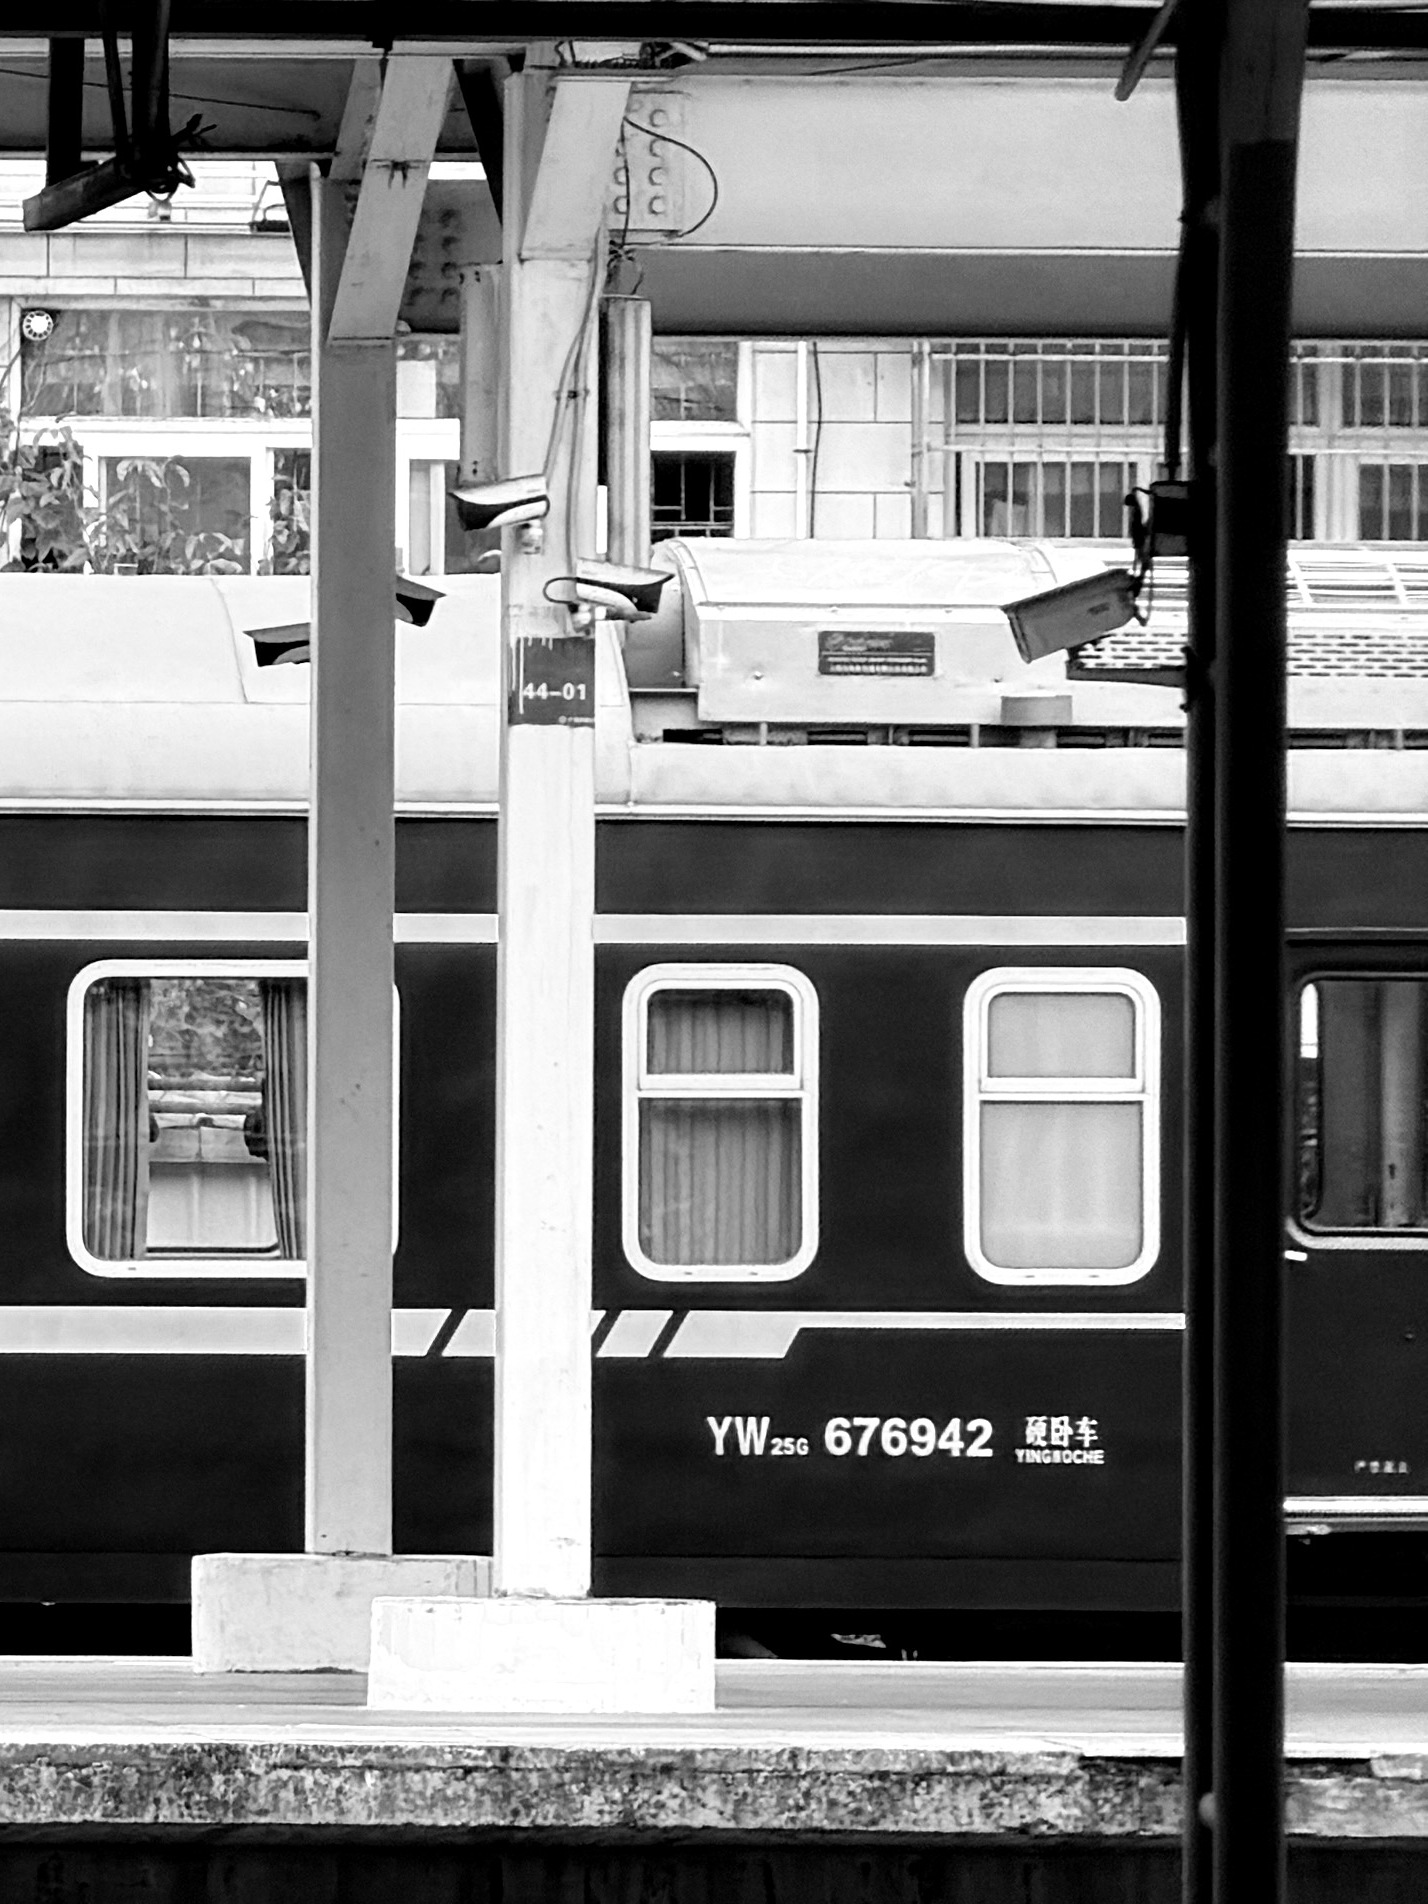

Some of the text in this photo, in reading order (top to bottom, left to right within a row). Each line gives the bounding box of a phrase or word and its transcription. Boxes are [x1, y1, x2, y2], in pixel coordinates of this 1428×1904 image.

[522, 682, 586, 700] 44-01
[823, 1416, 994, 1457] 676942
[1025, 1415, 1099, 1448] 硬卧车
